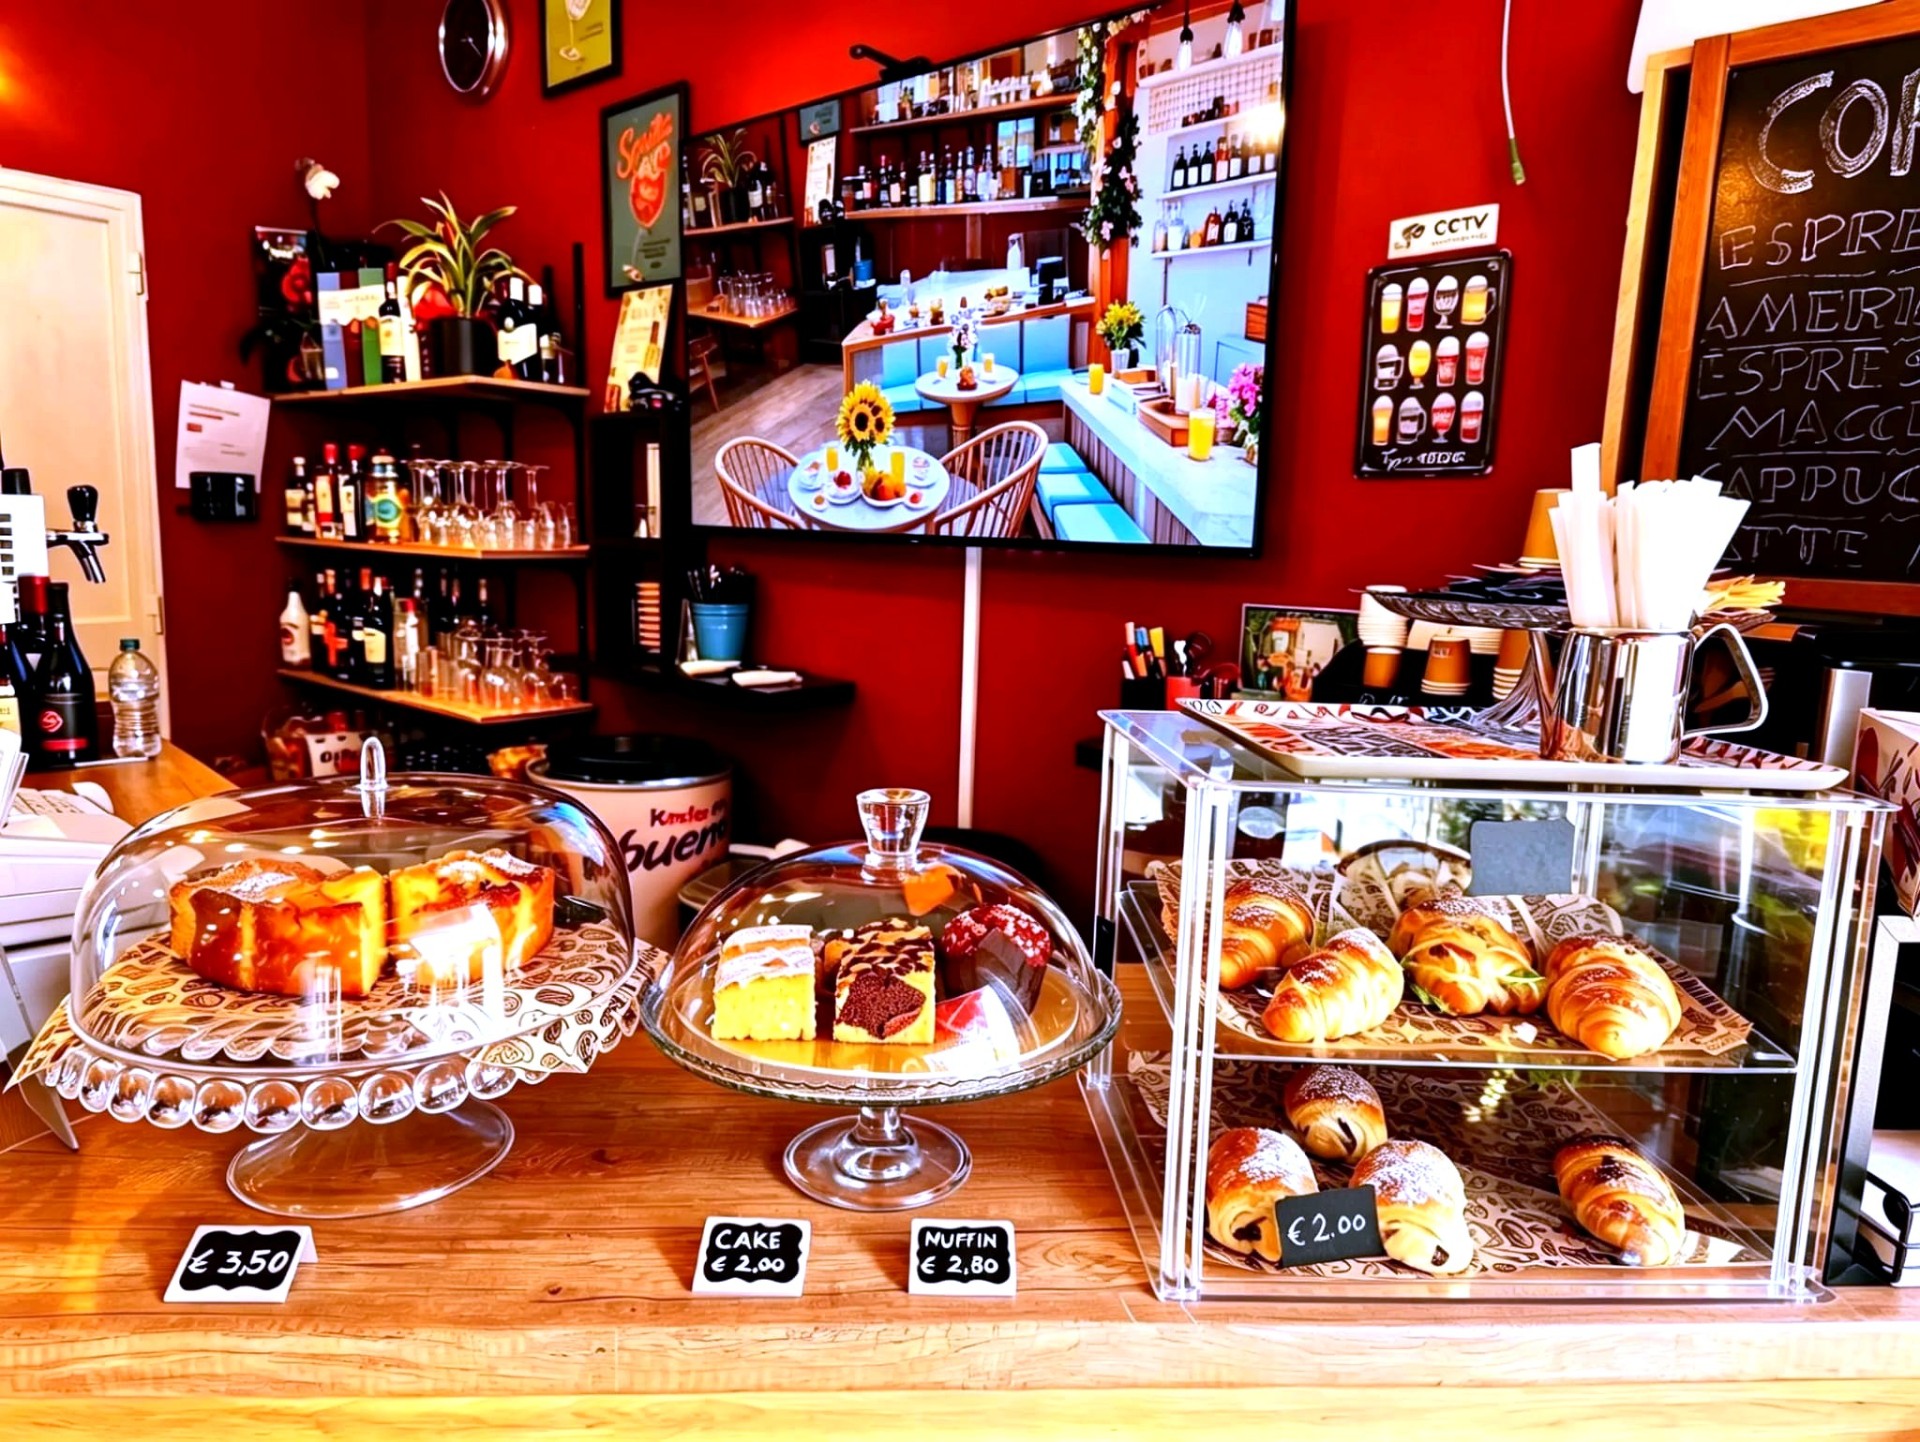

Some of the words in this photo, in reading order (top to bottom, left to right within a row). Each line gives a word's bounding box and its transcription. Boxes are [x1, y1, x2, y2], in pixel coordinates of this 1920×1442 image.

[1434, 213, 1489, 236] CCTV
[1706, 287, 1920, 339] AMERI
[715, 1229, 782, 1250] CAKE
[1287, 1216, 1305, 1246] €
[1312, 1213, 1366, 1242] 2.00
[188, 1249, 214, 1274] €
[217, 1249, 290, 1277] 3,50
[711, 1255, 727, 1273] €
[734, 1254, 785, 1274] 2.00
[920, 1255, 936, 1275] €
